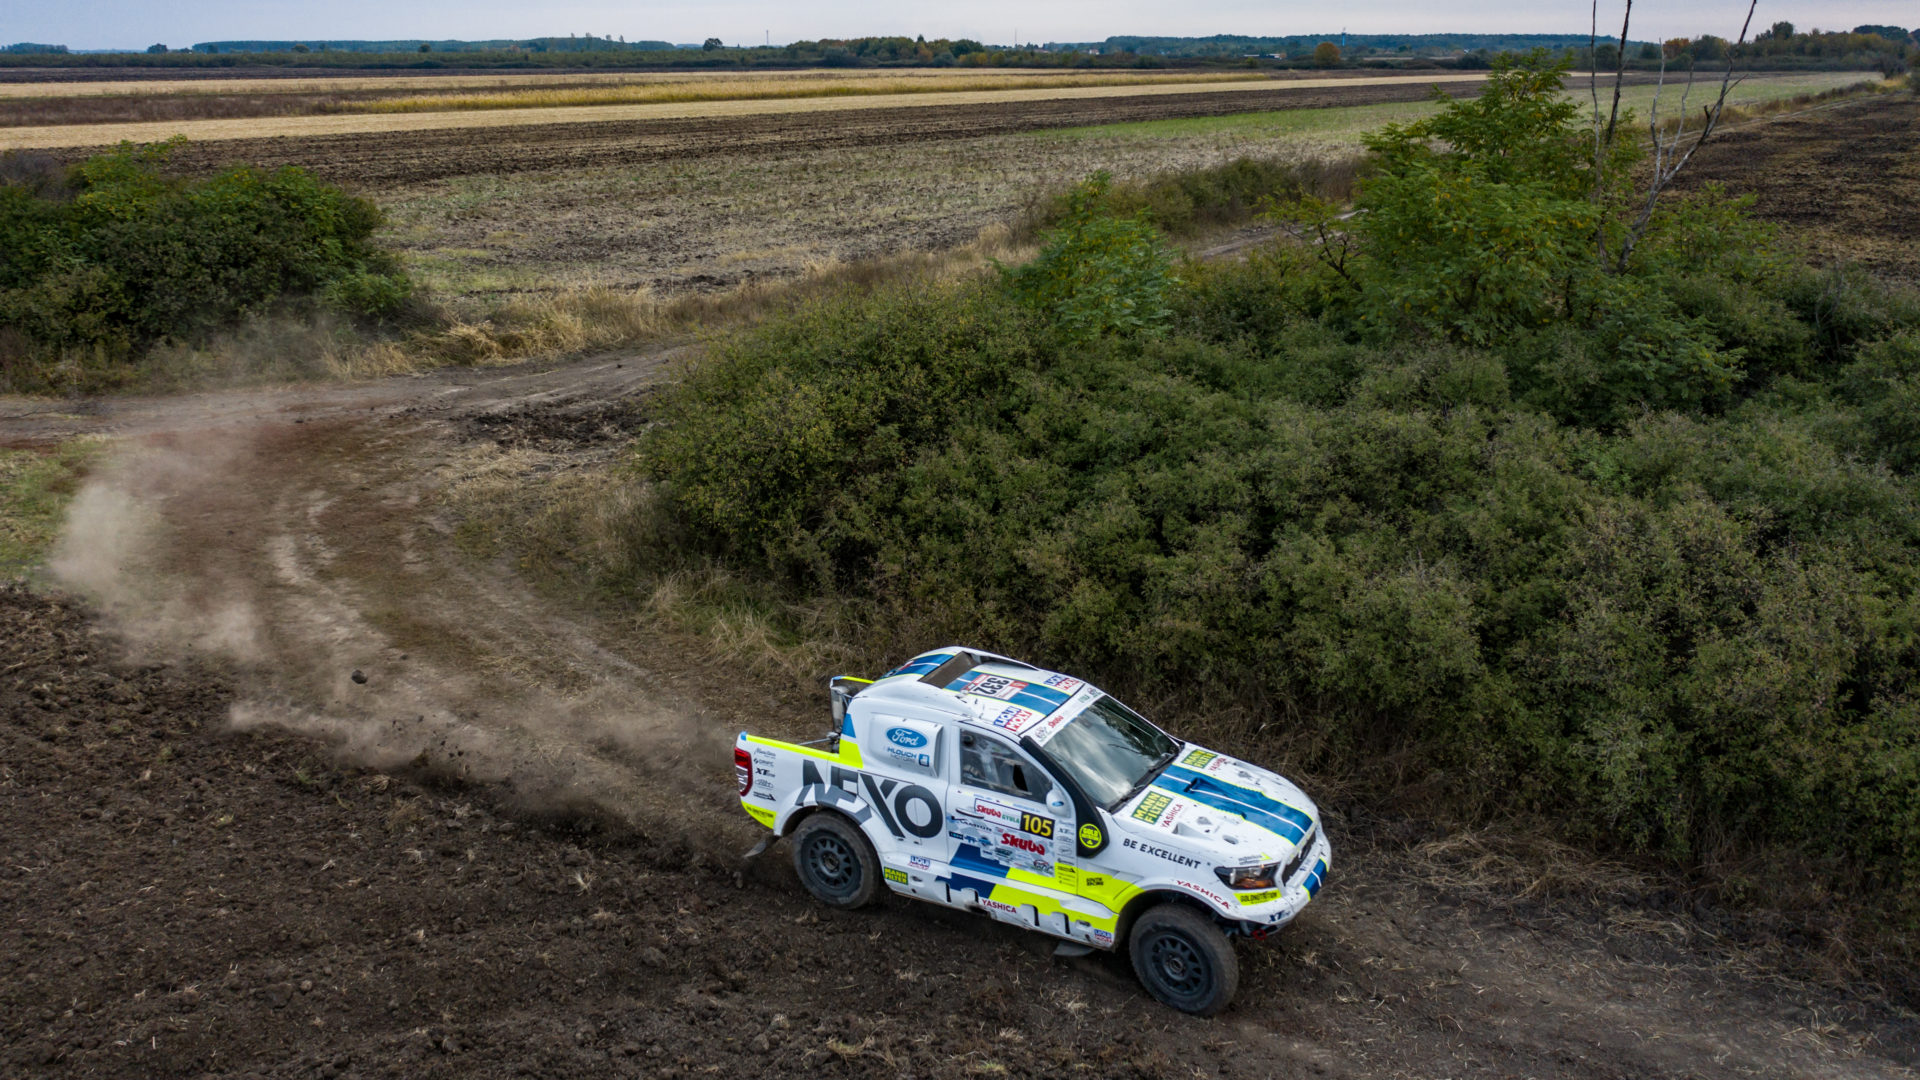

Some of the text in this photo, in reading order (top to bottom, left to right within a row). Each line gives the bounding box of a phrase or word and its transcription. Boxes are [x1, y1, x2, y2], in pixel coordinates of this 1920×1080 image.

[972, 677, 1010, 695] 332
[993, 706, 1033, 733] LIQUI MOLY
[891, 728, 919, 746] Ford
[887, 747, 917, 759] HLOUCH
[795, 759, 944, 839] NEXO
[1133, 791, 1161, 819] MANN
[1144, 796, 1173, 824] FILTER
[1023, 814, 1053, 838] 105
[1161, 803, 1184, 829] YASHICA
[1123, 838, 1202, 869] BE EXCELLENT
[884, 873, 907, 884] FILTER
[885, 867, 907, 879] MANN
[982, 899, 1017, 914] YASHICA
[1176, 880, 1230, 910] YASHICA
